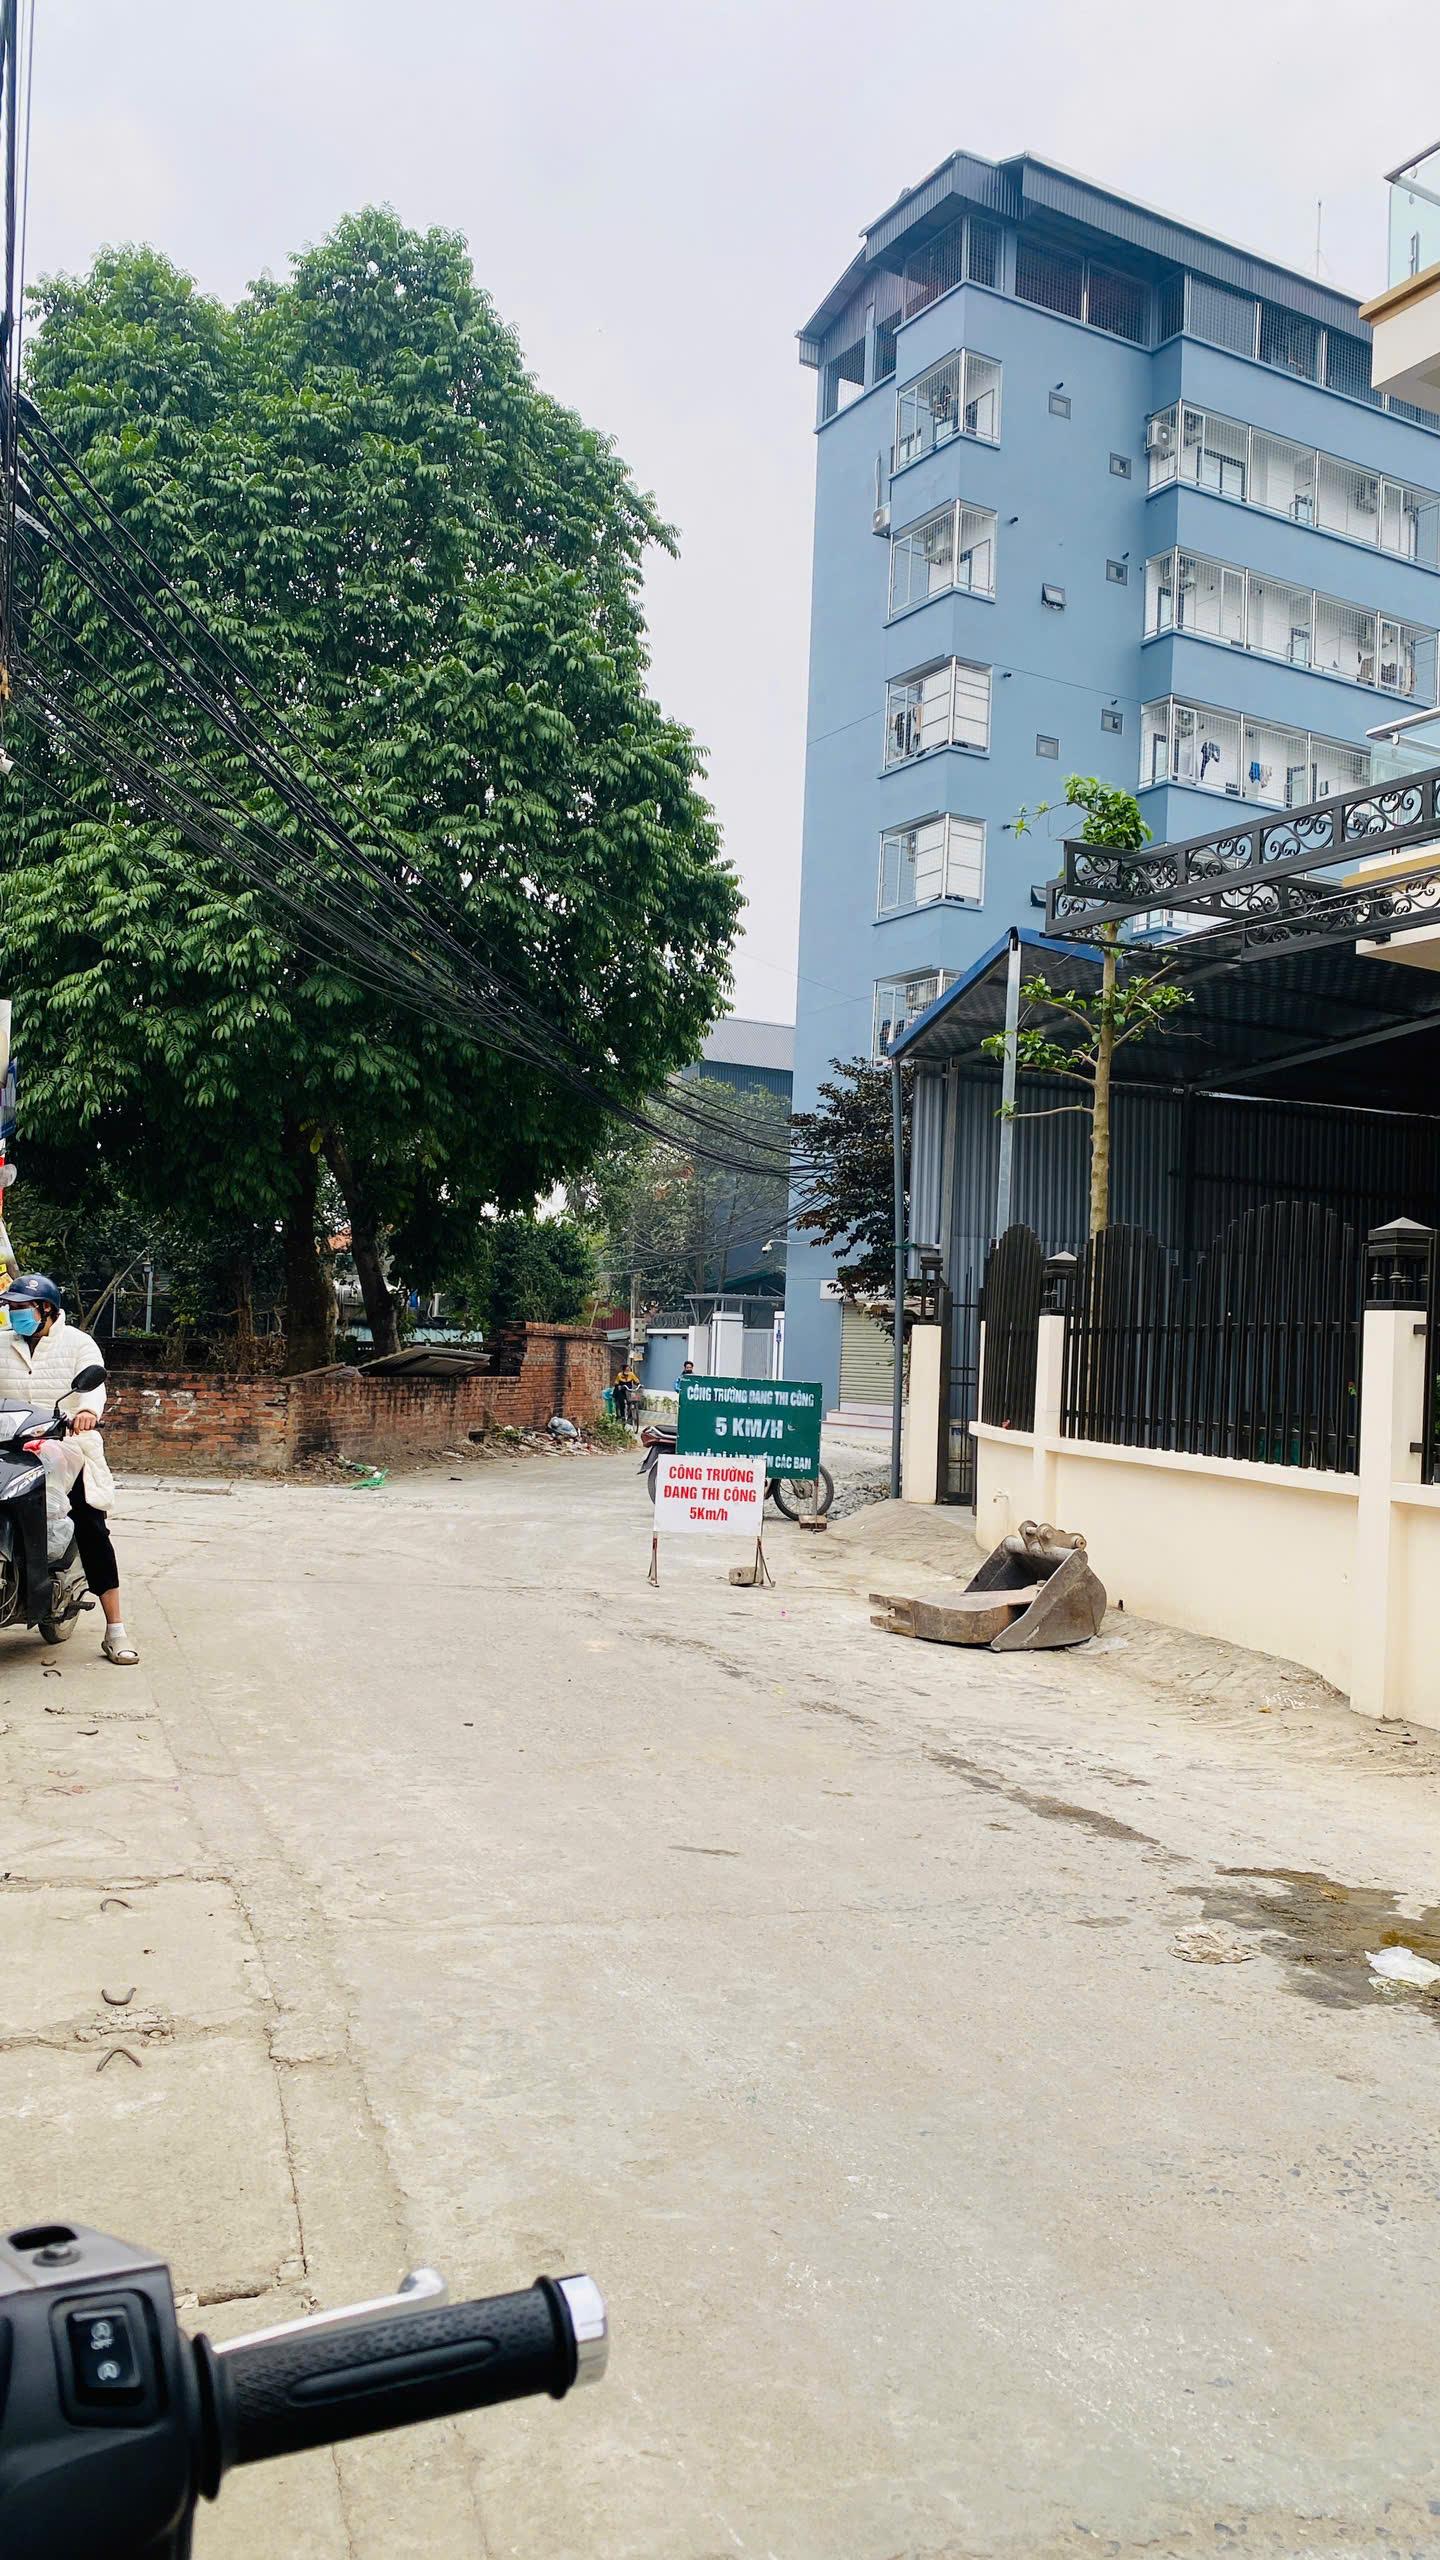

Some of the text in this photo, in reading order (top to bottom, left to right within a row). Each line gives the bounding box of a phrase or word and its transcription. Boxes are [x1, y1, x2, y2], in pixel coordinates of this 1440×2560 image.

[687, 1383, 712, 1400] CÔNG
[713, 1386, 747, 1403] TRƯỜNG
[774, 1391, 789, 1406] THI
[790, 1390, 815, 1407] CÔNG
[715, 1416, 784, 1439] 5 KM/H
[774, 1454, 792, 1469] CÁC
[793, 1456, 812, 1472] BẠN
[669, 1464, 754, 1483] CÔNG TRƯỜNG
[664, 1485, 757, 1502] ĐANG THI CÔNG
[689, 1506, 728, 1521] 5Km/h
